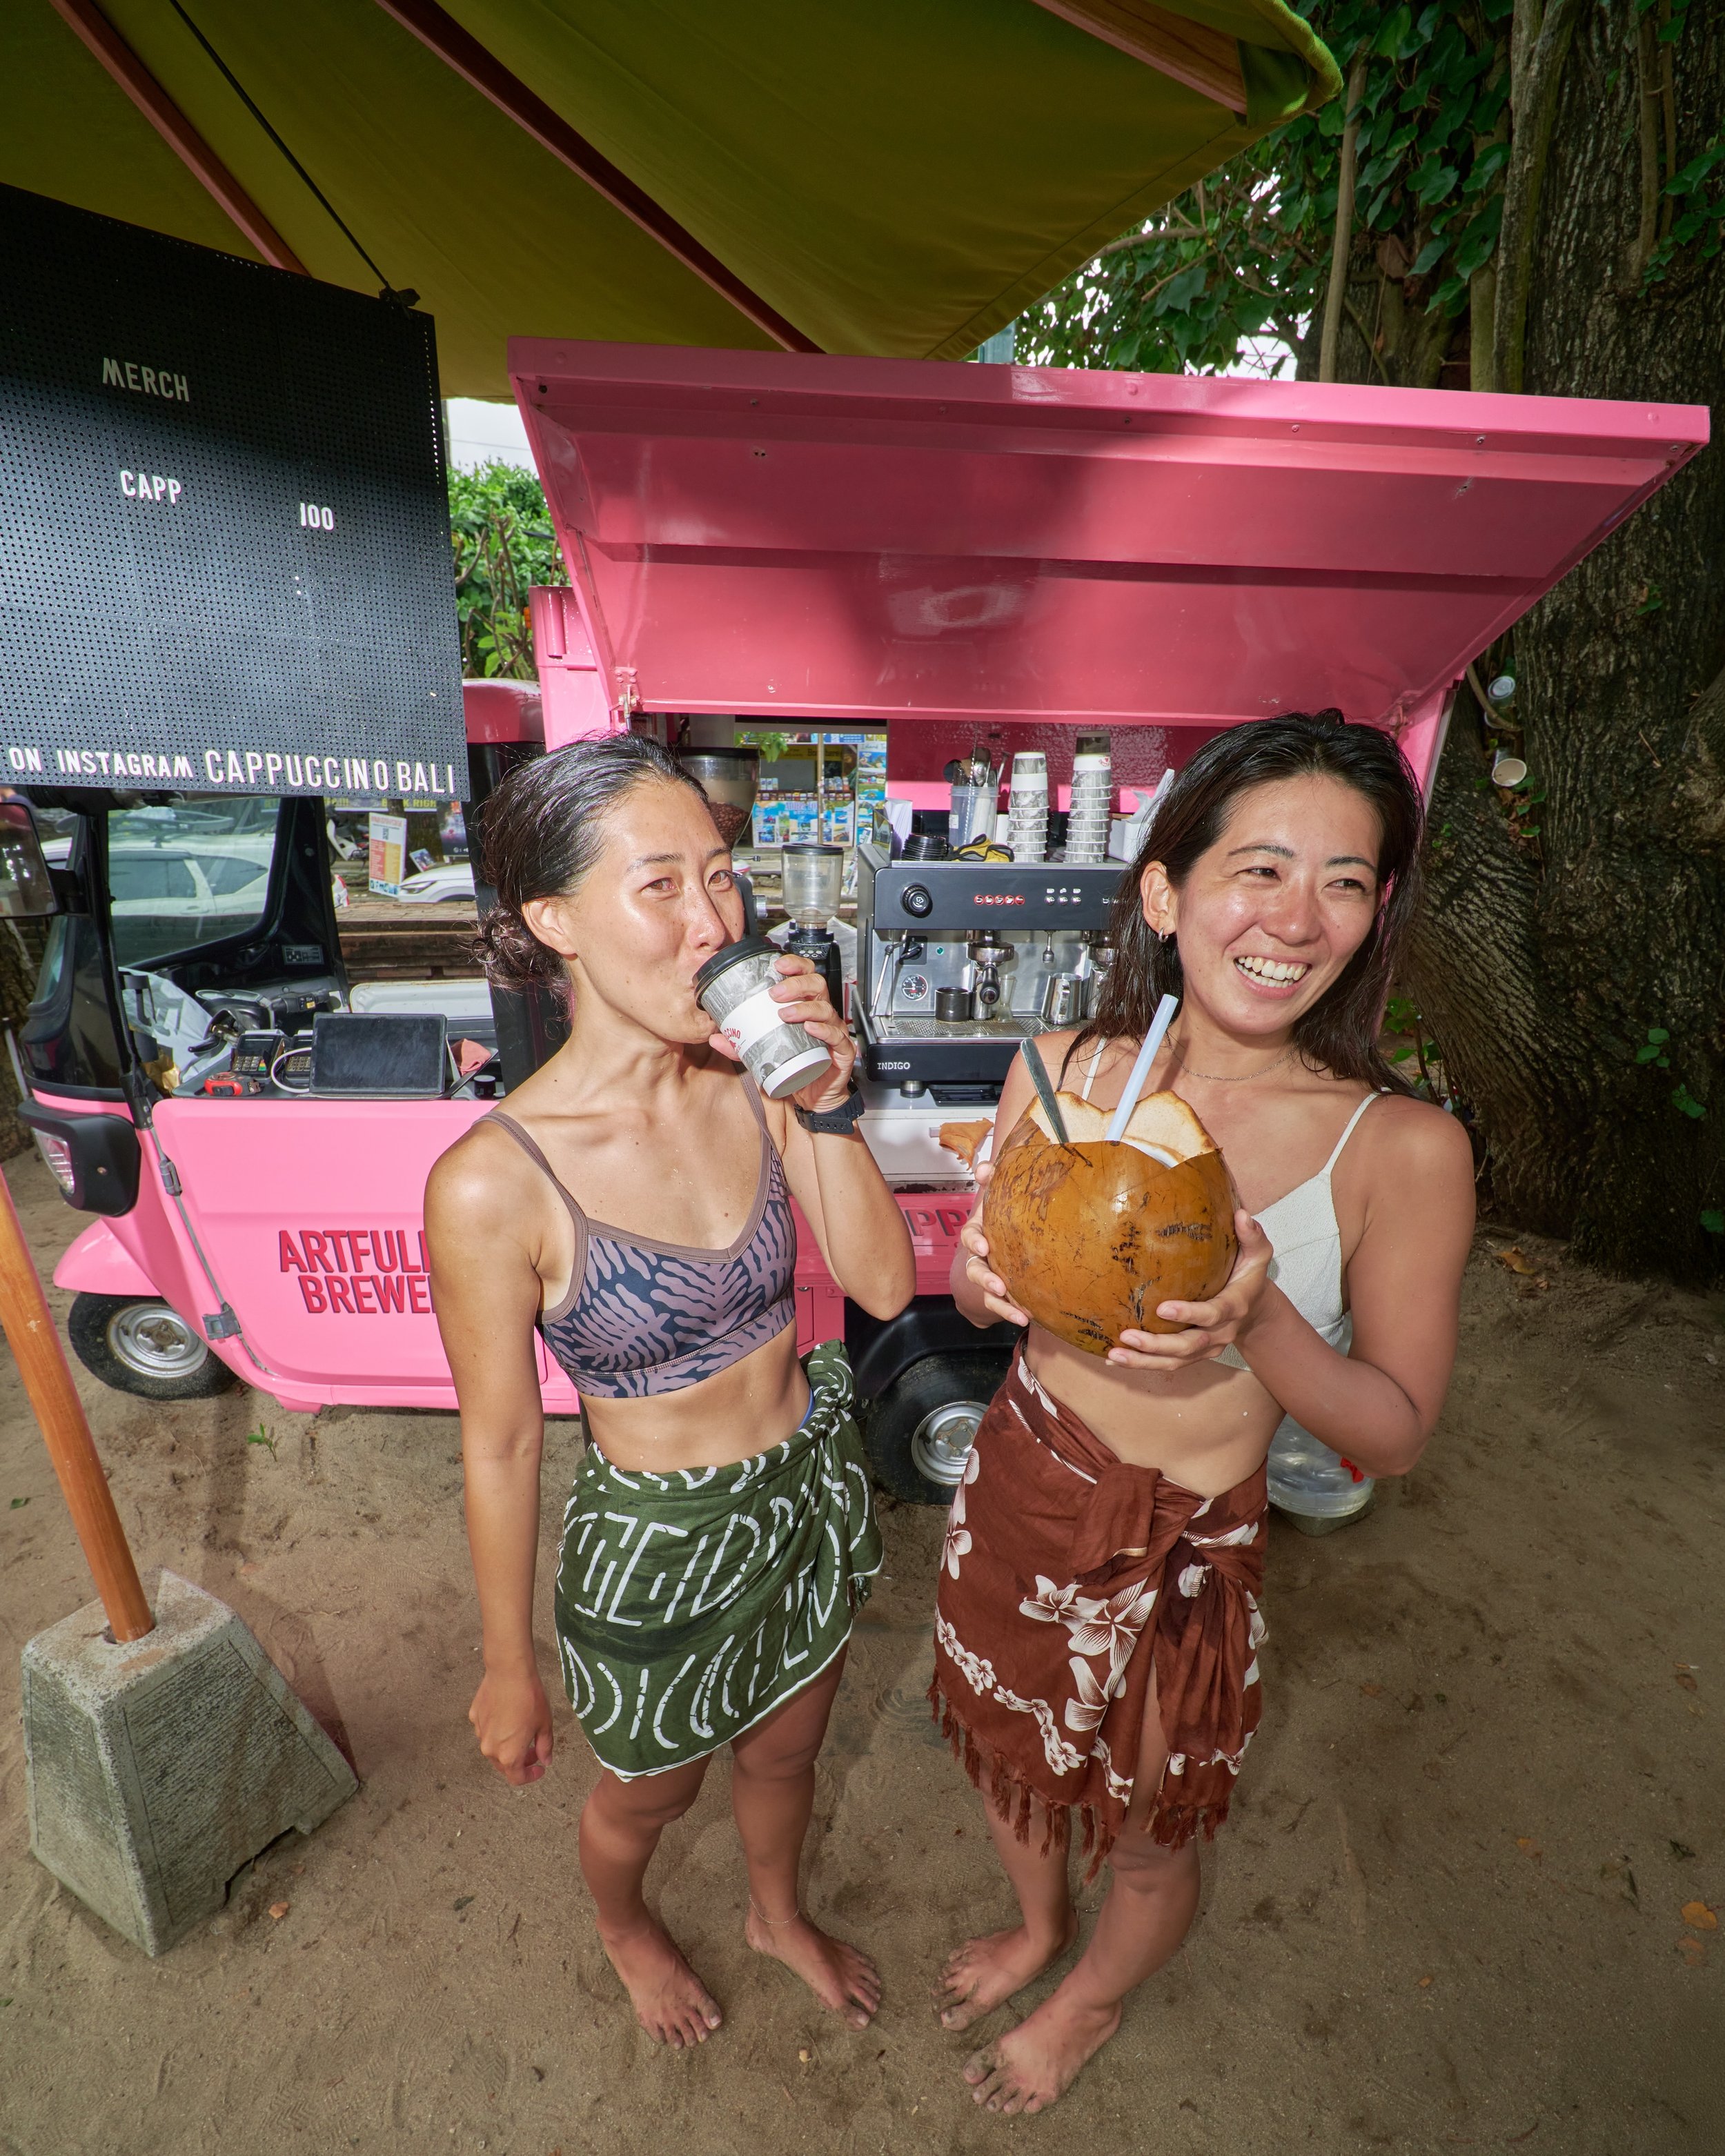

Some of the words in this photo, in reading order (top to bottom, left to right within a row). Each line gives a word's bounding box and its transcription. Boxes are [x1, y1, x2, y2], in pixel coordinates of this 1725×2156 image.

[102, 357, 190, 402] MERCH
[120, 470, 181, 504] CAPP
[8, 747, 42, 771] ON
[57, 749, 194, 778] INSTAGRAM
[204, 749, 389, 791] CAPPUCCINO
[396, 761, 454, 794] BALI
[413, 800, 437, 808] RIGH
[877, 1062, 911, 1070] INDIGO
[298, 1275, 437, 1314] BREWE
